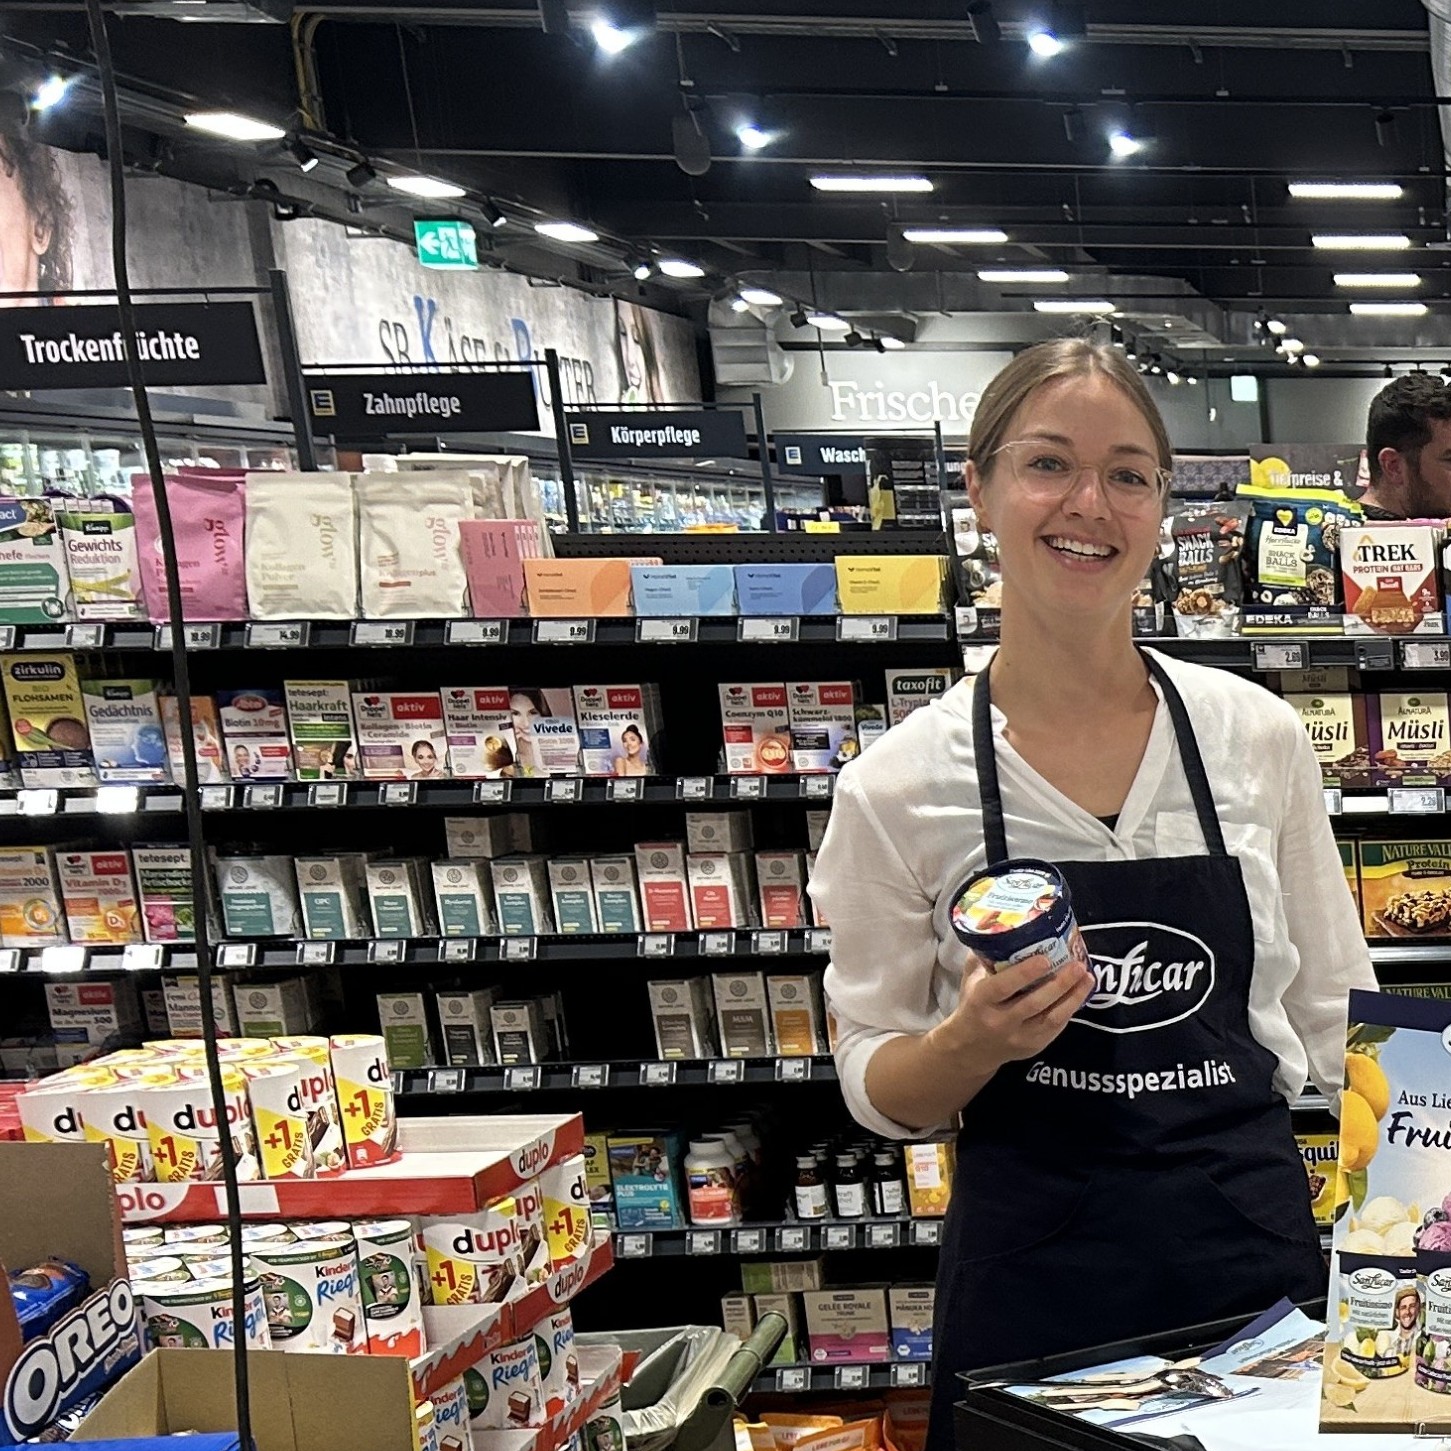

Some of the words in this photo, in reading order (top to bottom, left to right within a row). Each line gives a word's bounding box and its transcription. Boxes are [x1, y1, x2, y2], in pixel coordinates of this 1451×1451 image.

[20, 332, 201, 366] Trockenfüchte
[363, 392, 462, 418] Zahnpflege
[611, 426, 701, 446] Körperpflege
[820, 446, 866, 464] Wasch
[1333, 471, 1343, 486] &
[68, 539, 123, 553] Gewichts
[1177, 530, 1212, 552] SNACK
[70, 553, 121, 566] Reduktion
[1178, 549, 1213, 567] BALLS
[1359, 543, 1417, 563] TREK
[1353, 565, 1389, 574] PROTEIN
[1246, 614, 1293, 626] EDEKA
[896, 676, 943, 694] taxofit
[288, 698, 348, 714] Haarkraft
[1387, 719, 1444, 740] Müsli
[1382, 845, 1423, 860] NATURE
[1026, 1060, 1237, 1099] Genussspezialist
[345, 1091, 371, 1118] +1
[1398, 1090, 1428, 1107] Aus
[361, 1102, 386, 1138] GRATIS
[264, 1119, 291, 1150] +1
[281, 1131, 305, 1168] GRATIS
[518, 1137, 549, 1173] duplo
[554, 1265, 584, 1300] duplo
[8, 1280, 134, 1440] OREO
[490, 1347, 529, 1365] Kinder
[492, 1352, 537, 1390] Riegel
